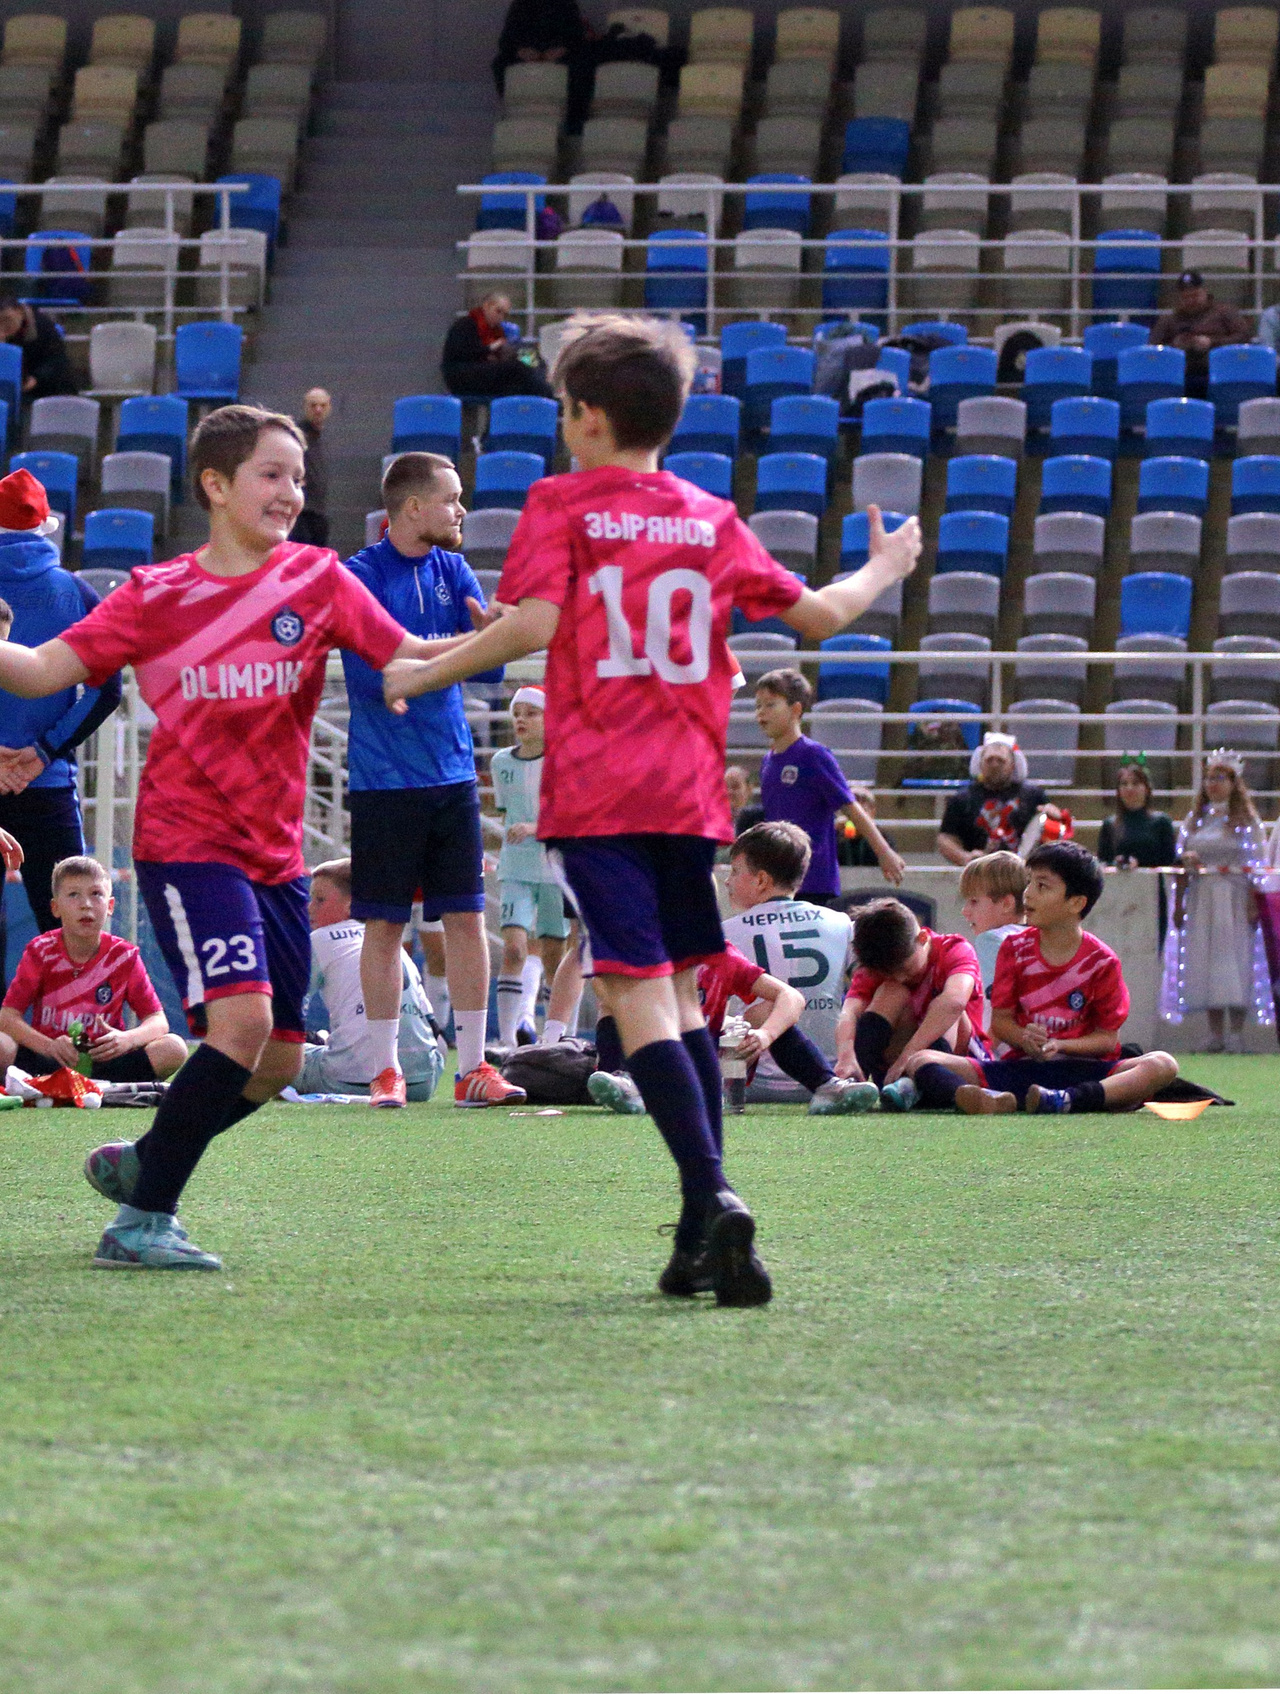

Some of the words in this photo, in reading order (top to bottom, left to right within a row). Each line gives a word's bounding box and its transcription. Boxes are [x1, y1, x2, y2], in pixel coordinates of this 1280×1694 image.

[584, 511, 716, 548] ЗЫРЯНОВ
[588, 565, 713, 685] 10
[180, 660, 303, 701] OLIMPIK
[742, 909, 824, 926] ЧЕРНЫХ
[202, 934, 258, 977] 23
[753, 929, 829, 988] 15
